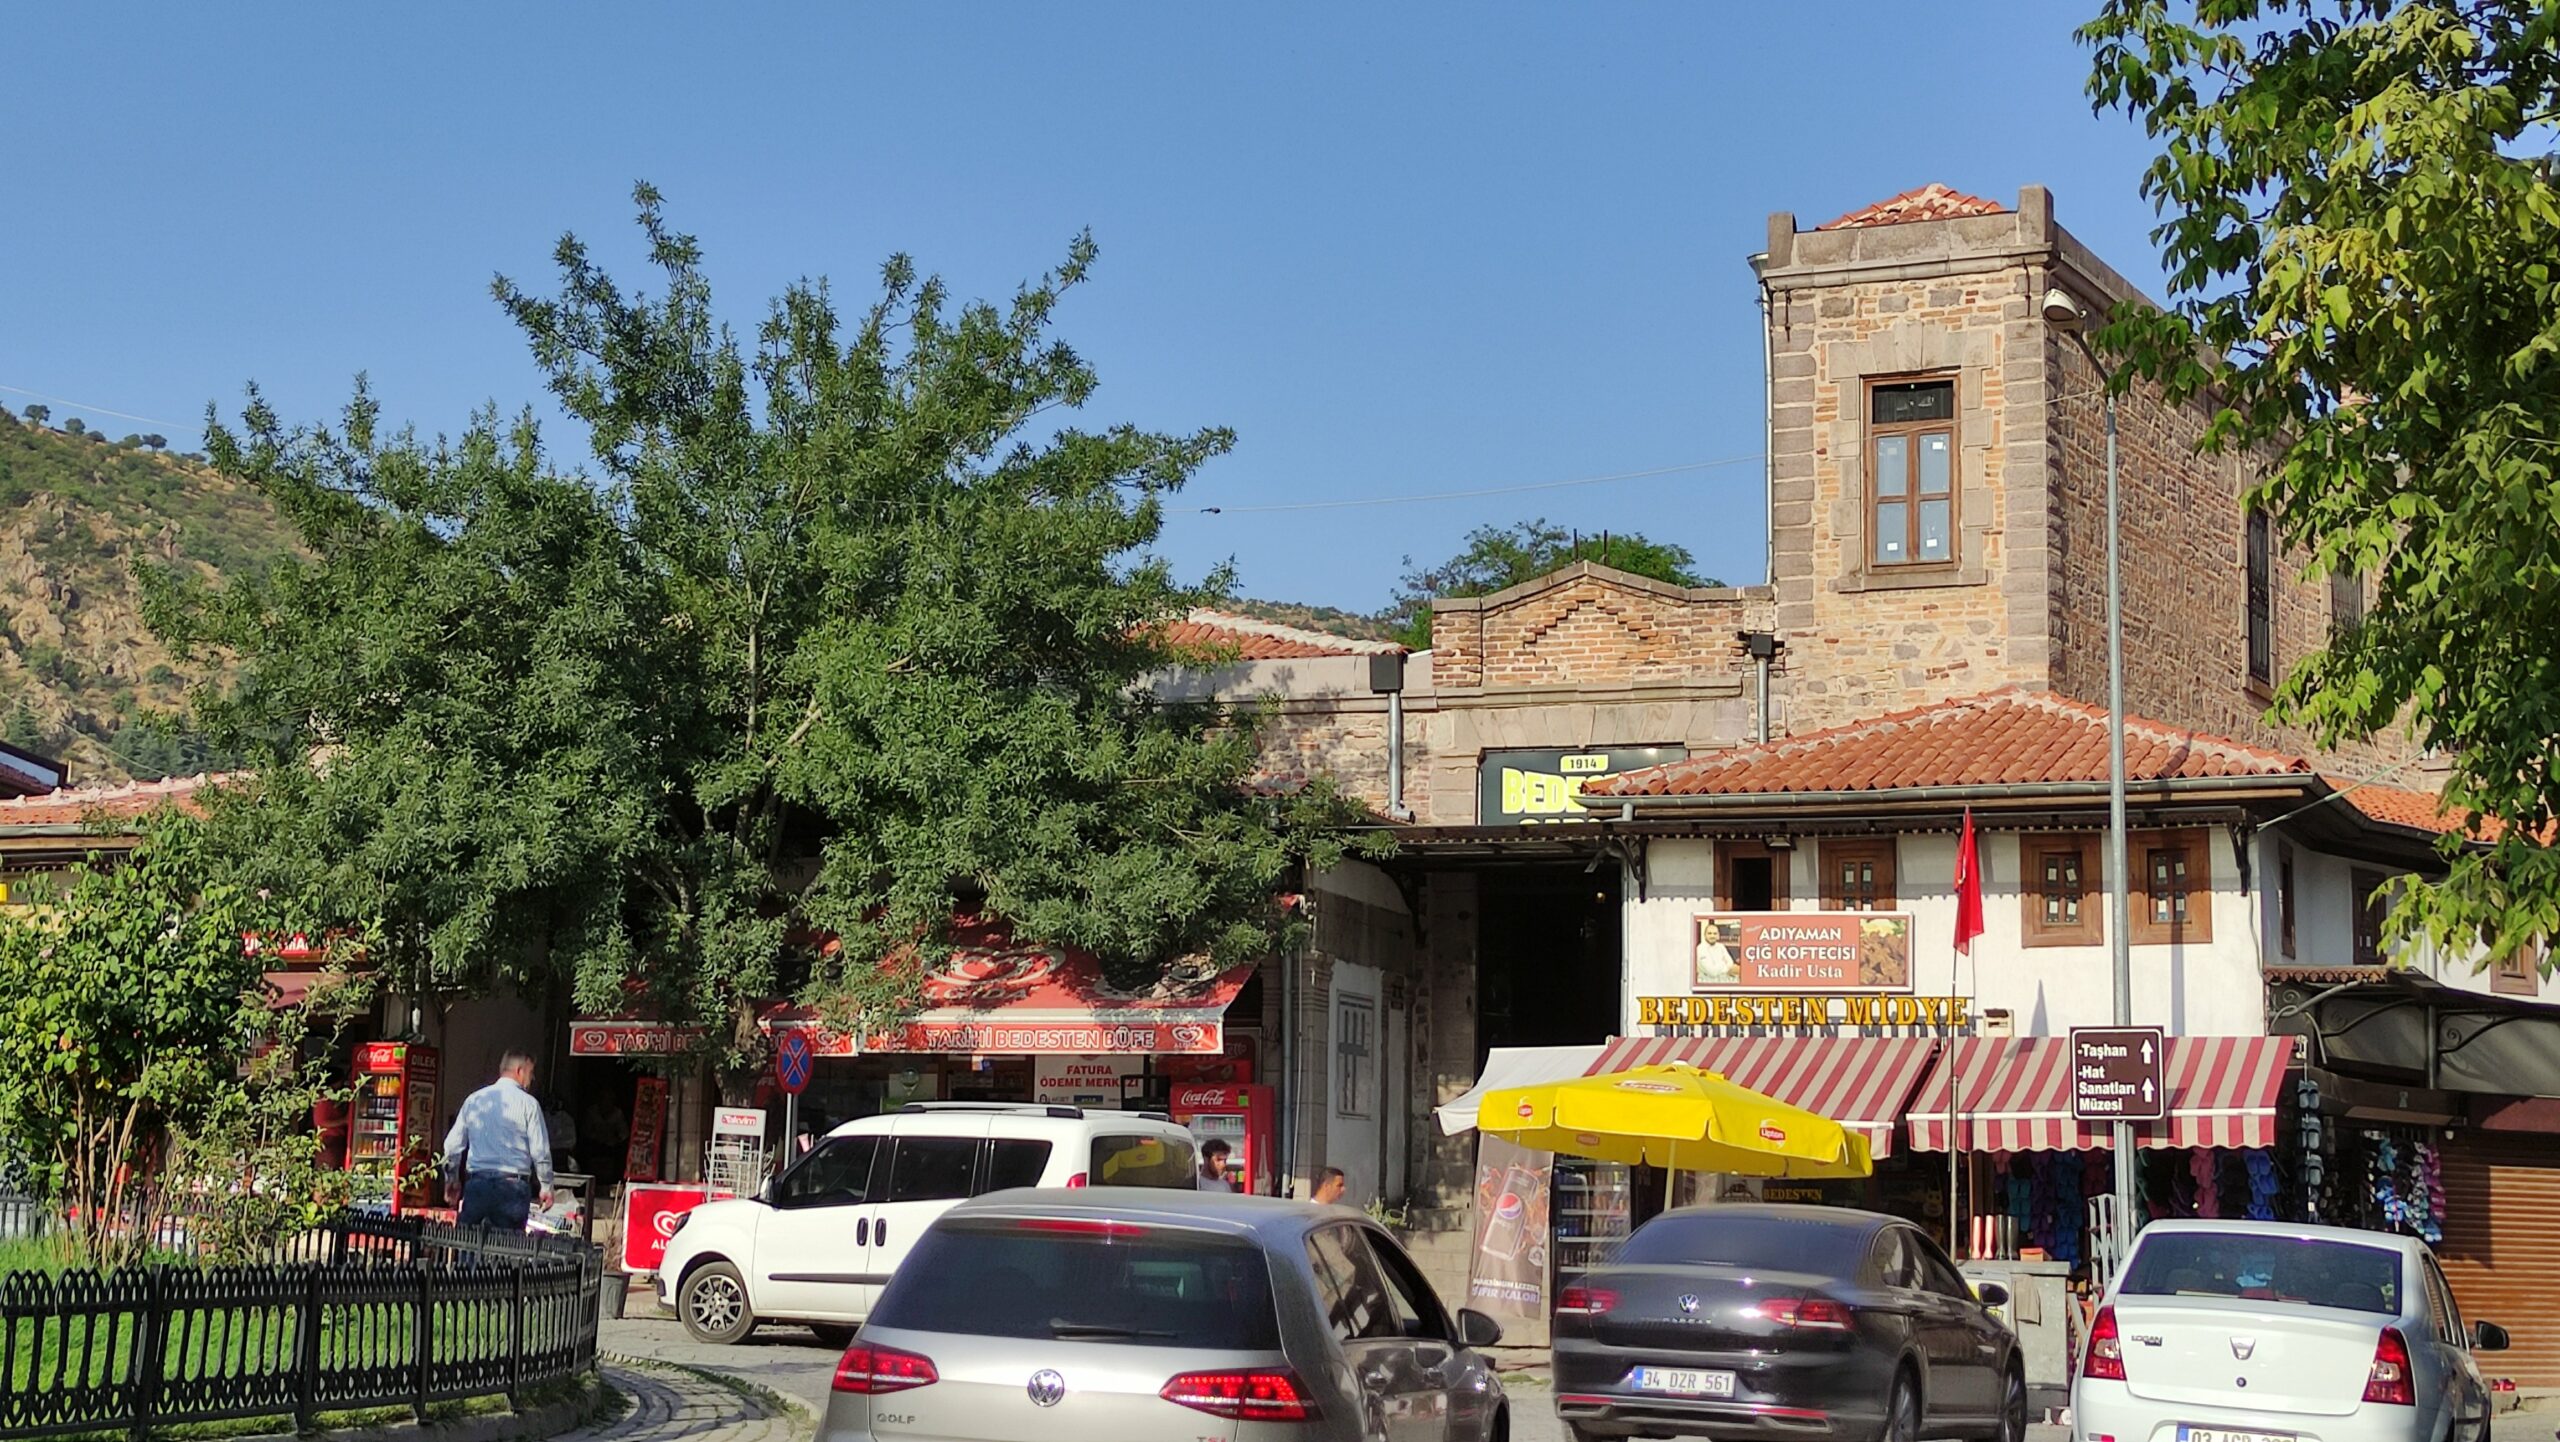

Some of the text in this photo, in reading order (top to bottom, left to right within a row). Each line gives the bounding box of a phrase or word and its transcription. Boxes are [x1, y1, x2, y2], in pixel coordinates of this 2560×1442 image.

[1570, 758, 1597, 769] 1914
[1502, 767, 1620, 814] BEDE
[1759, 927, 1842, 940] ADIYAMAN
[1745, 943, 1856, 963] ÇİĞ KÖFTECİSİ
[1757, 964, 1842, 978] Kadir Usta
[1638, 992, 1969, 1026] BEDESTEN MİDYE
[927, 1026, 993, 1049] TARİHİ
[995, 1029, 1100, 1049] BEDESTEN
[1104, 1027, 1155, 1049] BÜFE
[1067, 1065, 1113, 1075] FATURA
[1040, 1076, 1082, 1087] ÖDEME
[2079, 1081, 2136, 1095] Sanatları
[2079, 1098, 2123, 1111] Müzesi
[1643, 1371, 1730, 1391] 34 DZR 561
[877, 1413, 915, 1424] GOLF
